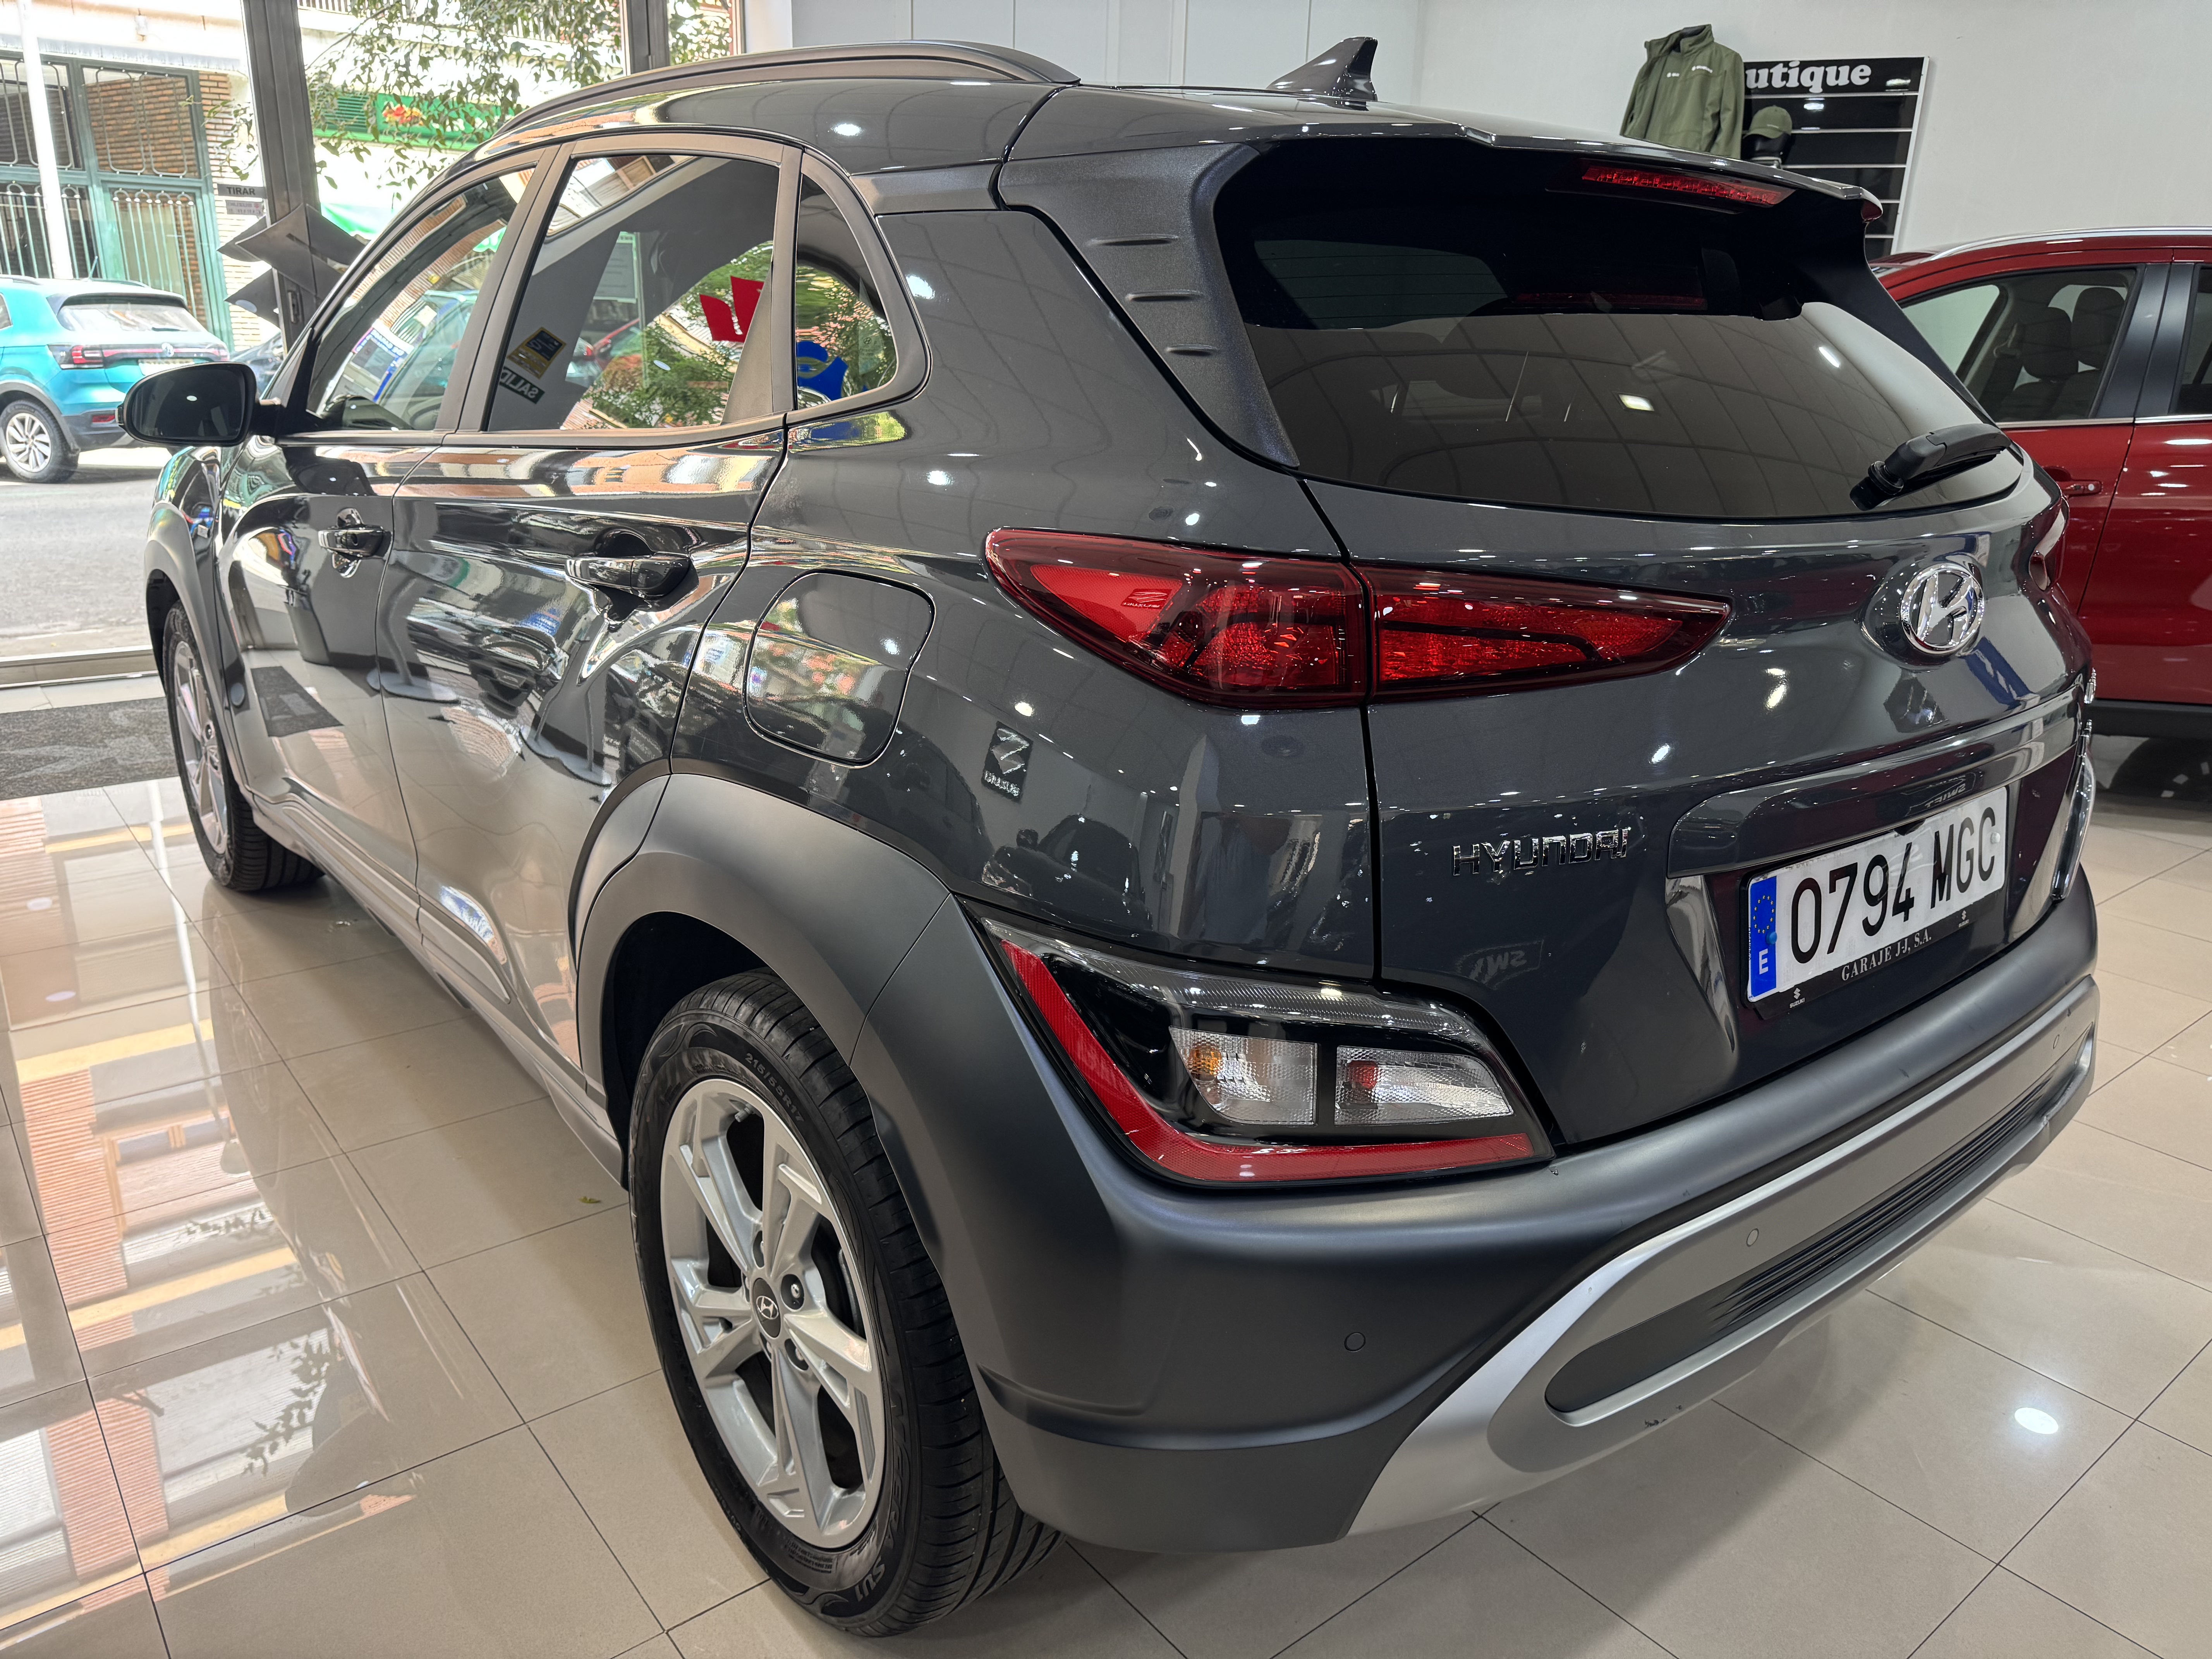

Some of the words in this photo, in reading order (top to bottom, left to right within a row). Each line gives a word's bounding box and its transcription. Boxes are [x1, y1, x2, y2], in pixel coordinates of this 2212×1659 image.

[226, 186, 256, 195] TIRAR
[1453, 828, 1632, 876] HYUNDAI
[1791, 842, 1915, 964] 0794
[1930, 807, 1996, 909] MGC
[1759, 949, 1769, 975] E
[1841, 948, 1892, 981] GARAJE
[1914, 929, 1932, 948] S.A.
[1790, 998, 1805, 1008] SUZUKI
[745, 1053, 805, 1122] 215/55R17
